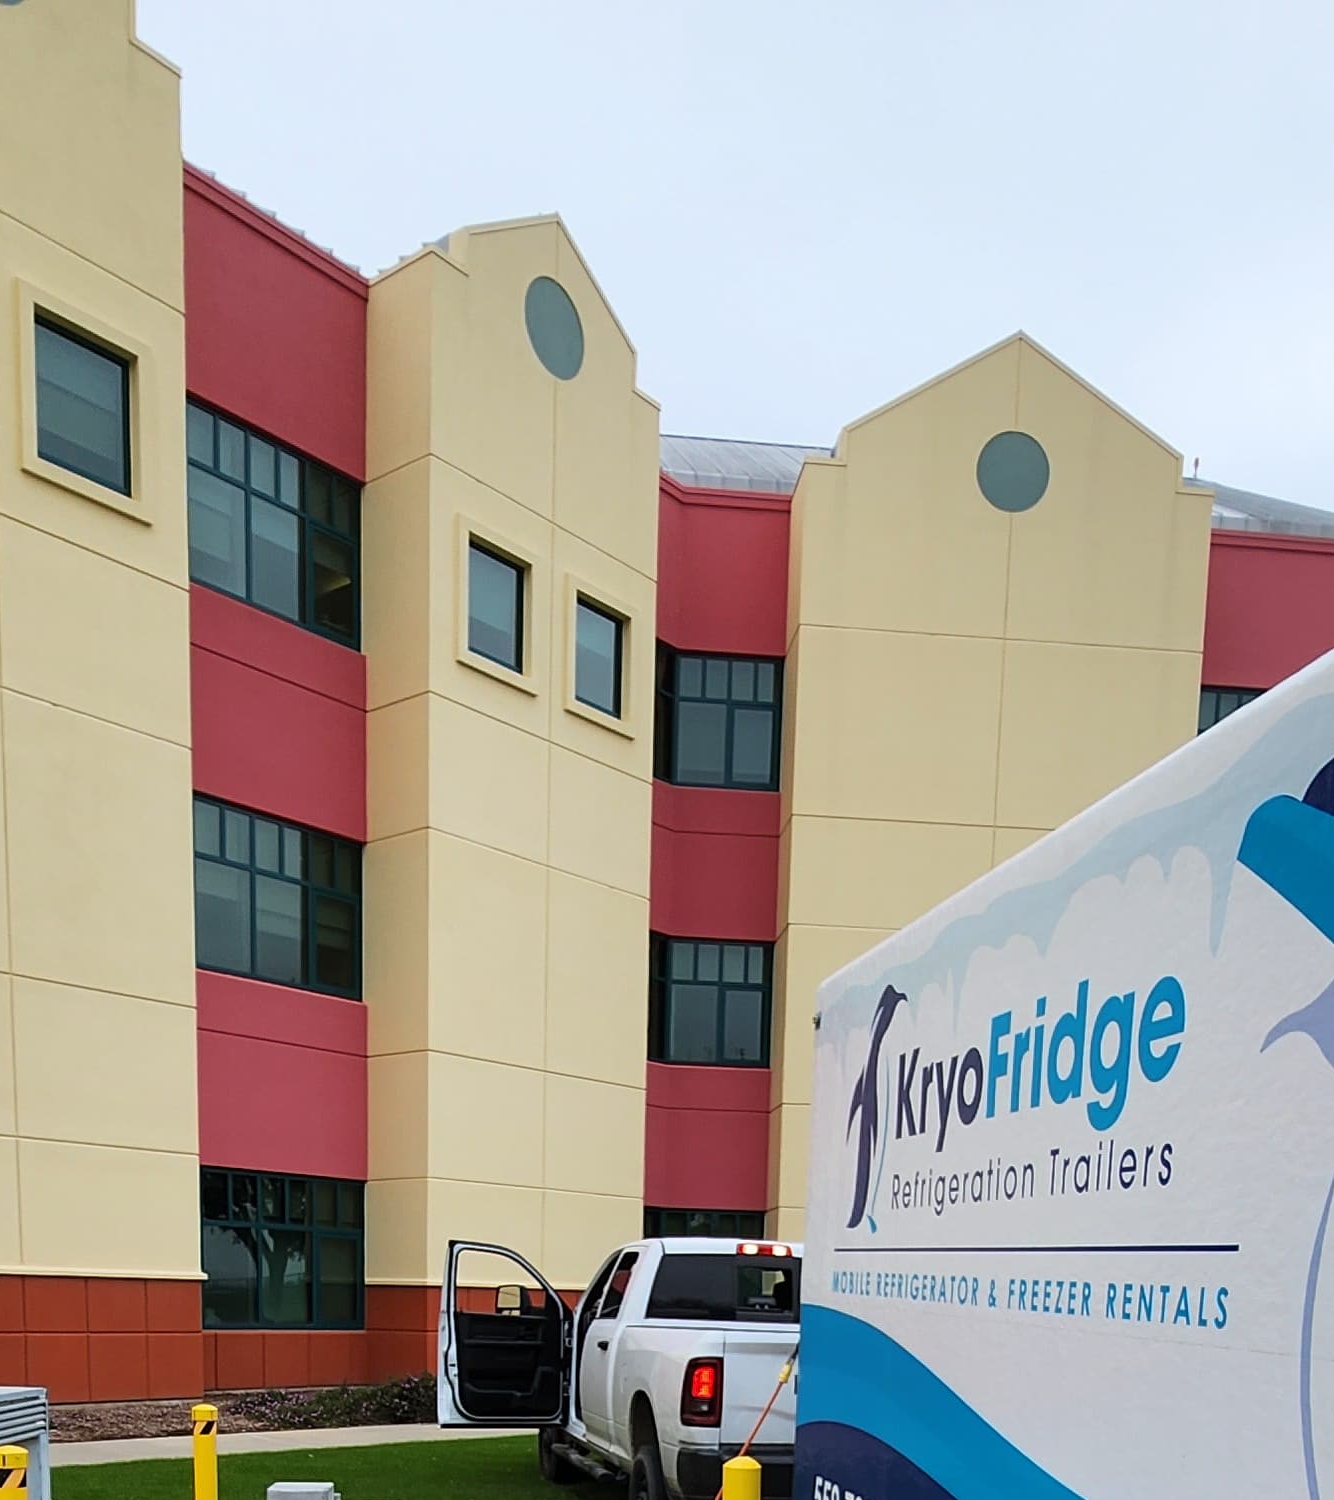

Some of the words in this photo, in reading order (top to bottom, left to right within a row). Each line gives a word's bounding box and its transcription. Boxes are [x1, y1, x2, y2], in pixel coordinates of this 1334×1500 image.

[895, 975, 1186, 1153] KryoFridge
[891, 1157, 1035, 1216] Refrigeration
[1049, 1139, 1174, 1196] Trailers
[832, 1271, 871, 1297] MOBILE
[876, 1272, 979, 1307] REFRIGERATOR
[988, 1279, 997, 1308] &
[1007, 1278, 1092, 1317] FREEZER
[1105, 1282, 1229, 1330] RENTALS
